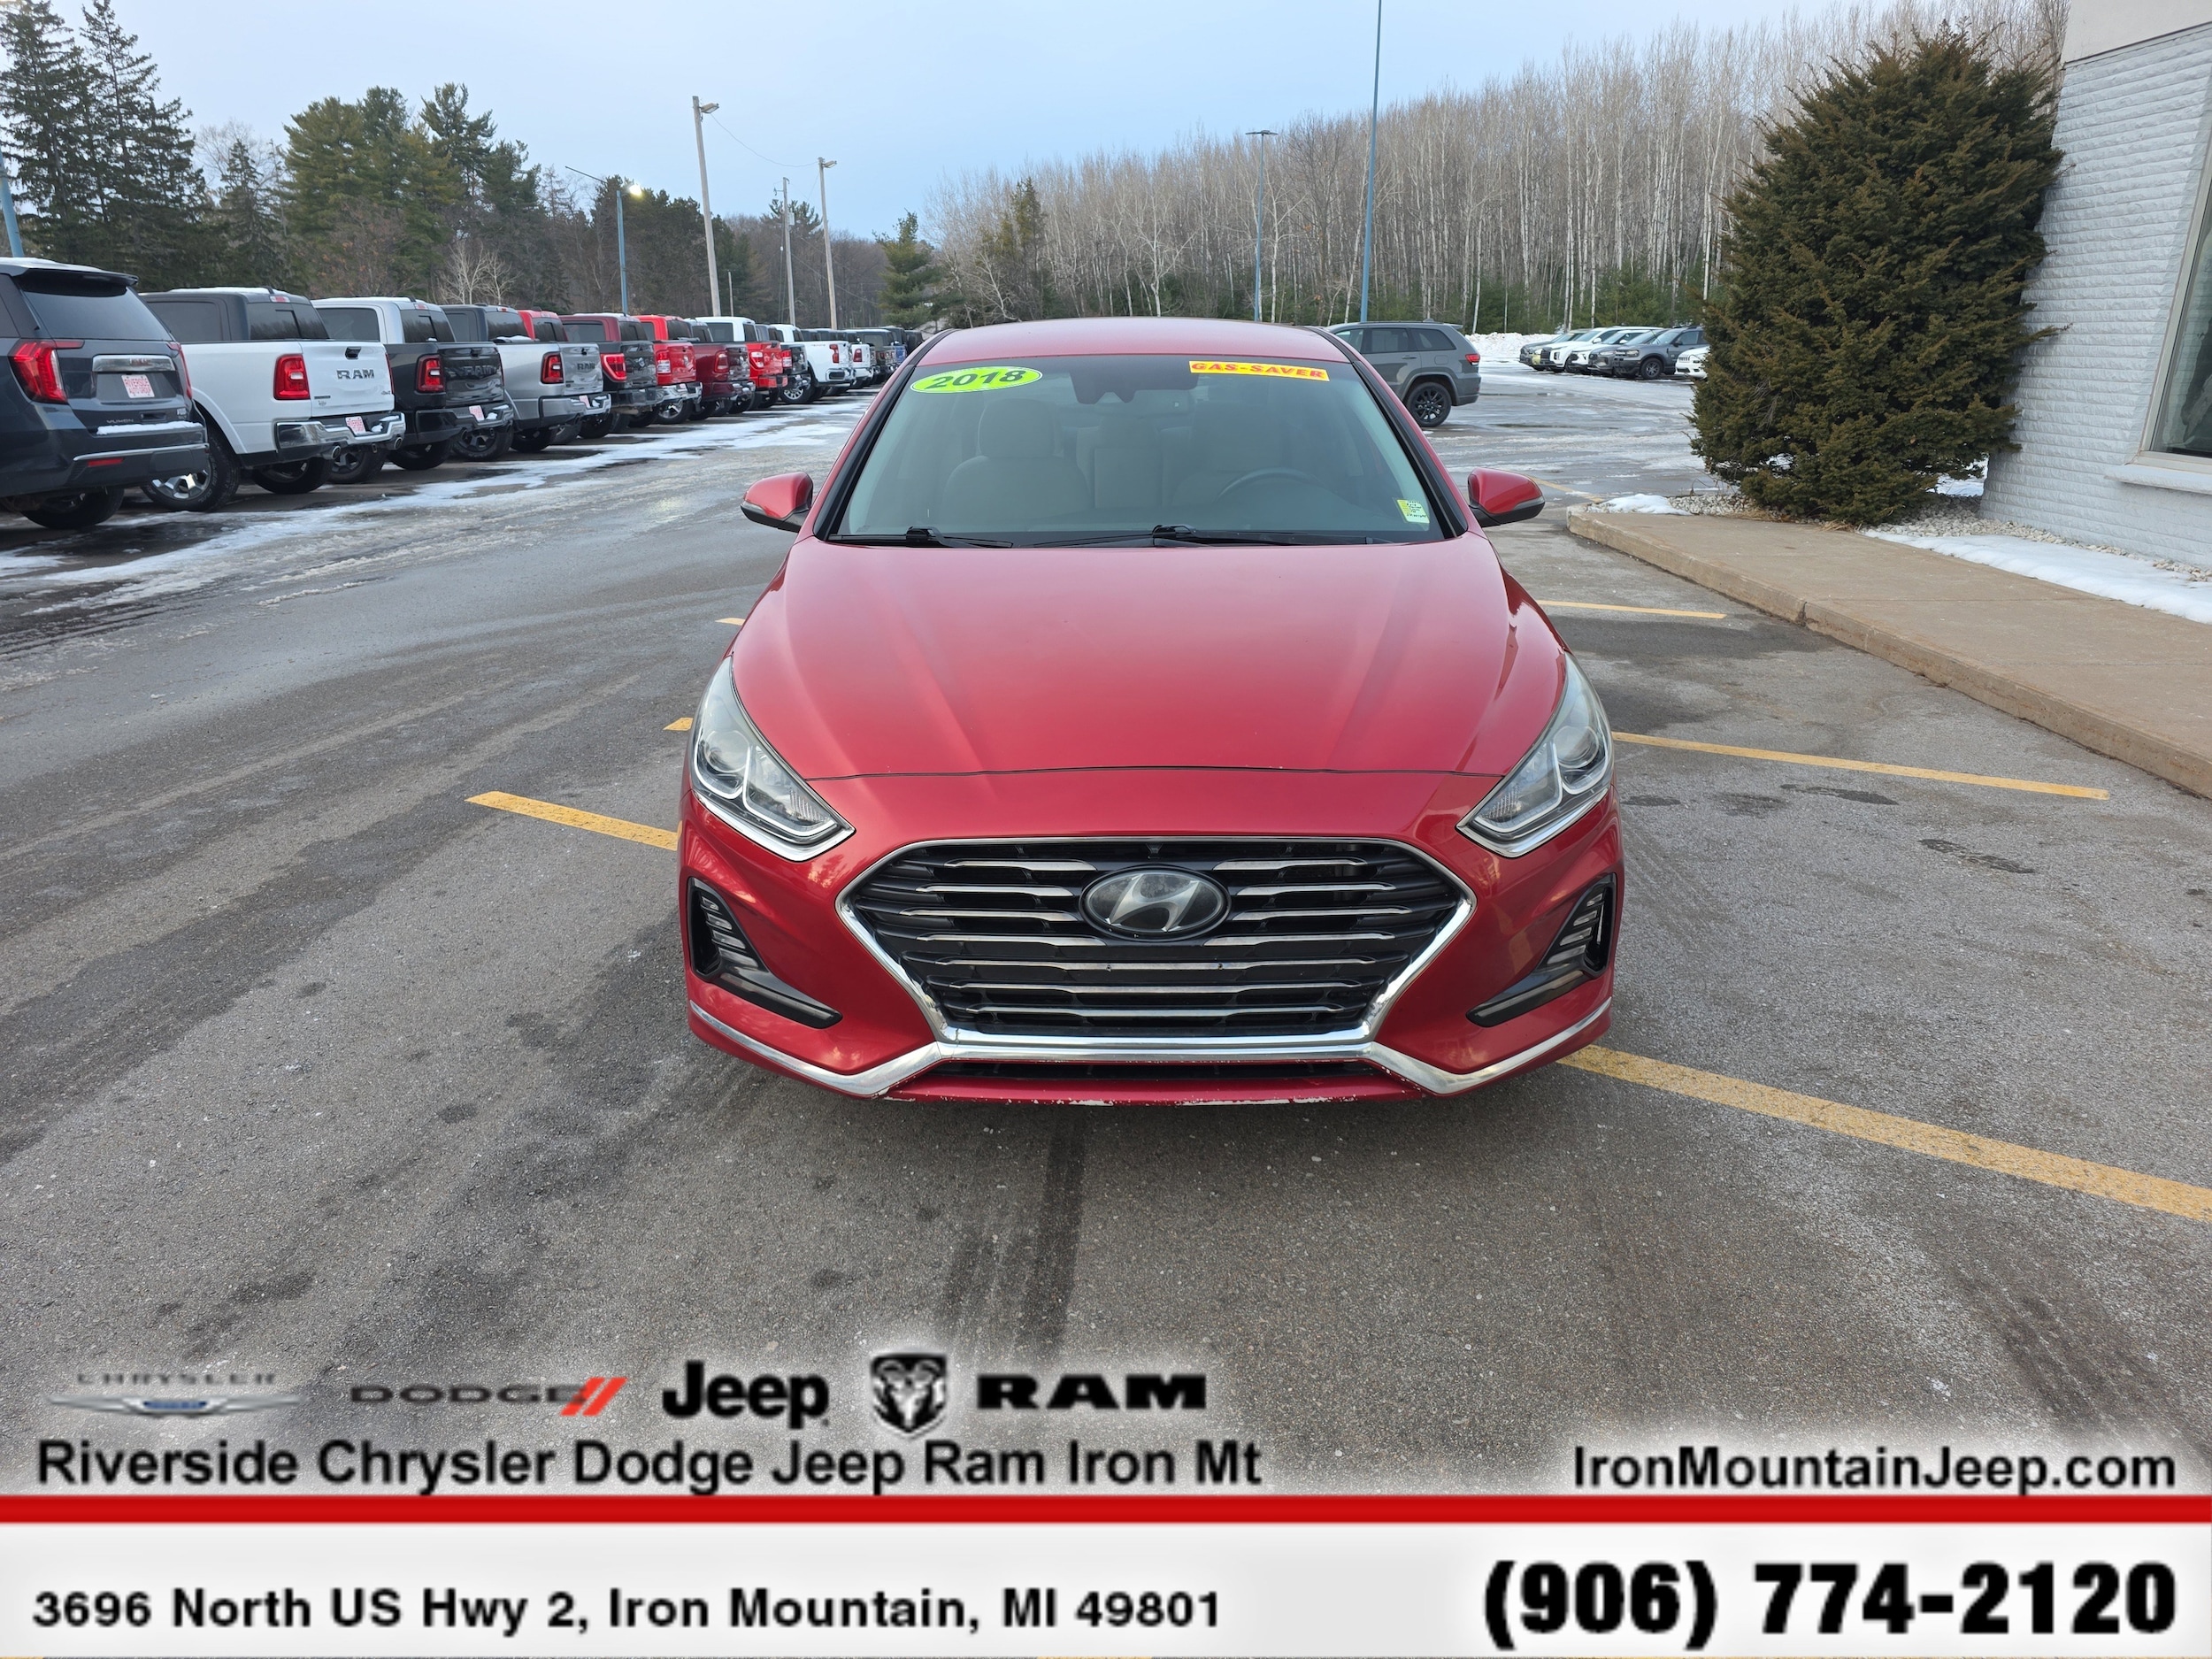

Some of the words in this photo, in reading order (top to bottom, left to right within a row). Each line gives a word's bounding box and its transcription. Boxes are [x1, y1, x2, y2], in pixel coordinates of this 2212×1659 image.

[336, 369, 375, 380] RAM
[1191, 363, 1324, 379] GAS-SAVER
[924, 370, 1026, 389] 2018
